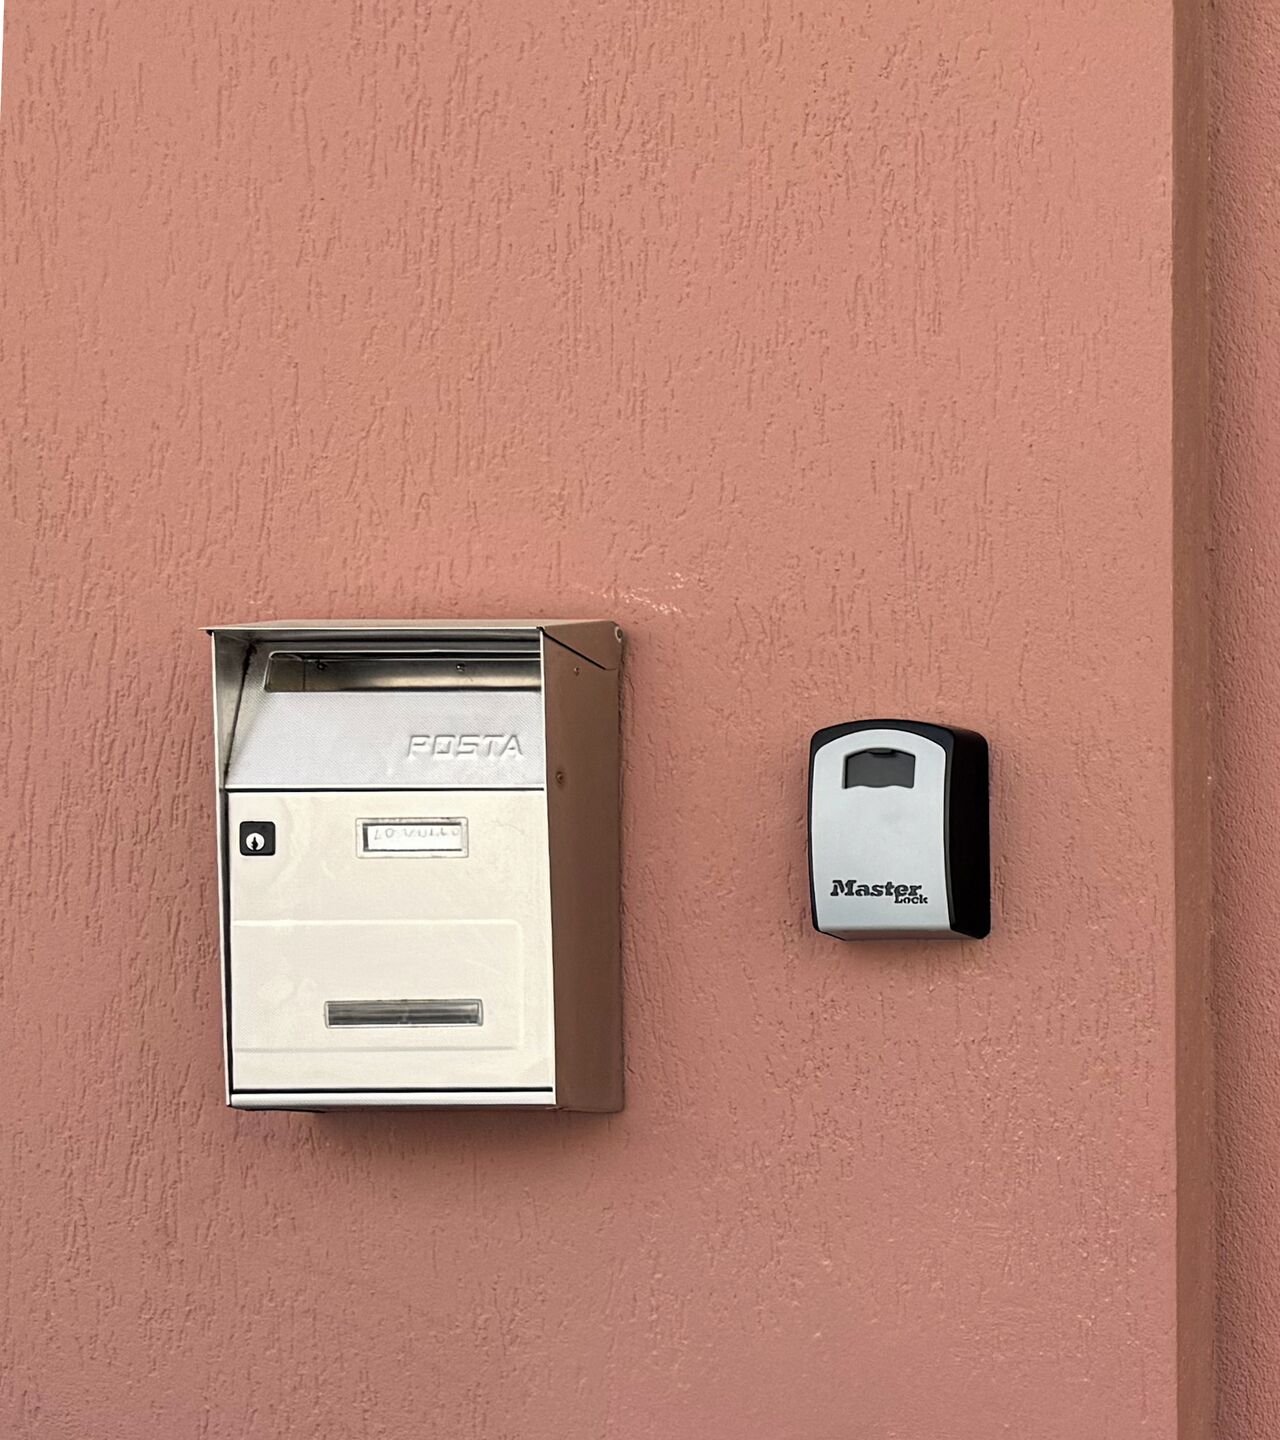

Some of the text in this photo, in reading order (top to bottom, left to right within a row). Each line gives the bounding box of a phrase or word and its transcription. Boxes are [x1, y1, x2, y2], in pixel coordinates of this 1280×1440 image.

[407, 734, 523, 757] POSTA
[830, 879, 922, 896] Master
[894, 894, 928, 904] Lock
